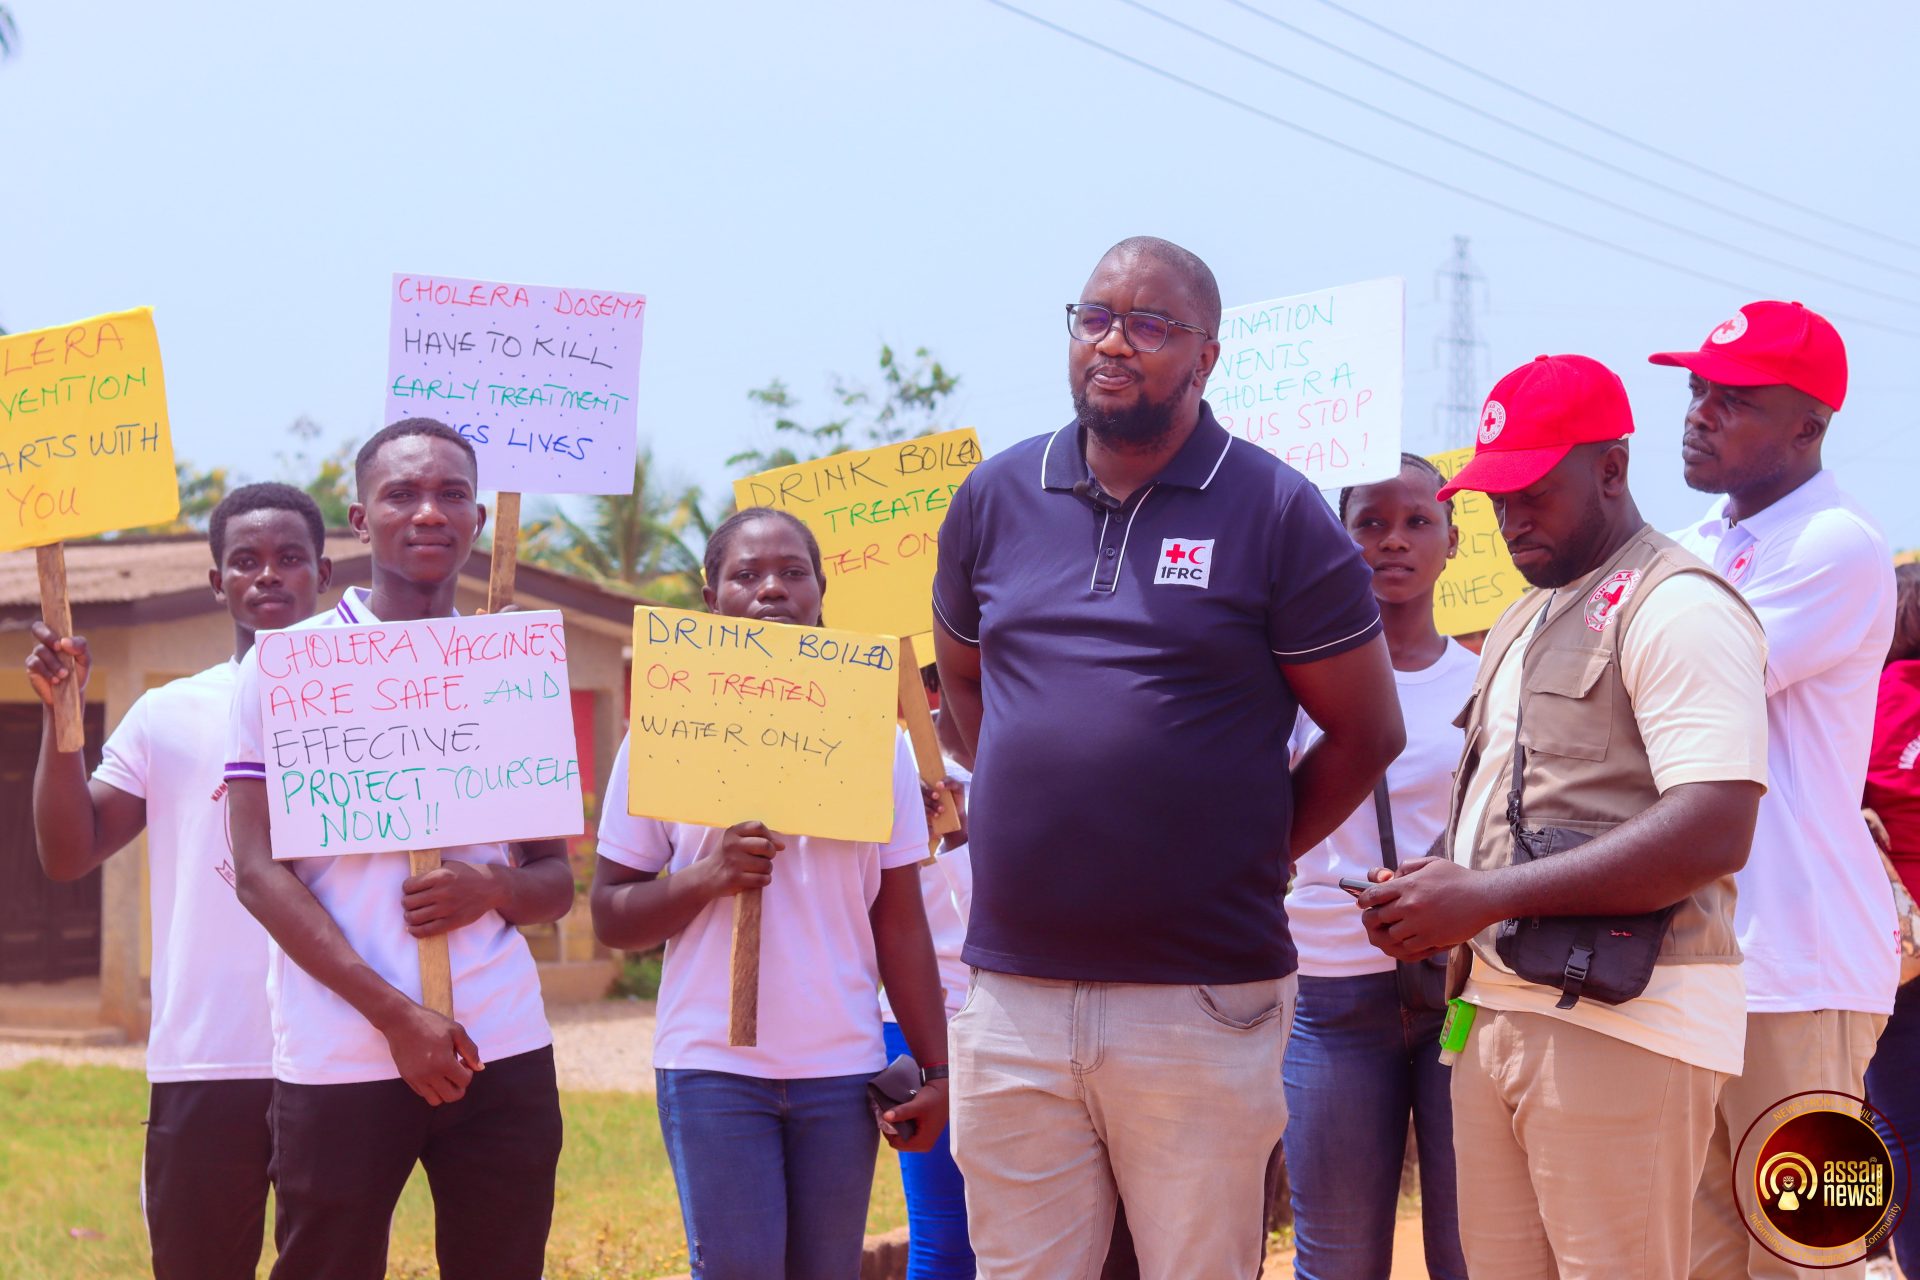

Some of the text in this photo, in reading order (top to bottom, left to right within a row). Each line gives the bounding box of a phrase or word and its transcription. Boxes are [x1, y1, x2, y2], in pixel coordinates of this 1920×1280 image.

[399, 278, 529, 308] CHOLERA
[404, 327, 613, 369] HAVE TO KILL
[1207, 340, 1313, 382] VENTS
[0, 367, 146, 421] VENTION
[392, 375, 629, 414] EARLY TREATMENT
[1297, 389, 1373, 430] STOP
[90, 422, 158, 456] WITH
[508, 428, 593, 460] LIVES
[750, 438, 982, 508] DRINK BOILED
[6, 484, 80, 527] YOU
[824, 543, 890, 576] TER
[1161, 566, 1203, 580] IFRC
[258, 623, 567, 679] CHOLERA VACCINES
[649, 612, 893, 671] DRINK BOILED
[269, 680, 354, 721] ARE
[483, 671, 560, 704] AND
[647, 664, 826, 707] OR TREATED
[641, 715, 842, 766] WATER ONLY
[281, 757, 578, 814] PROTECT YOURSELF
